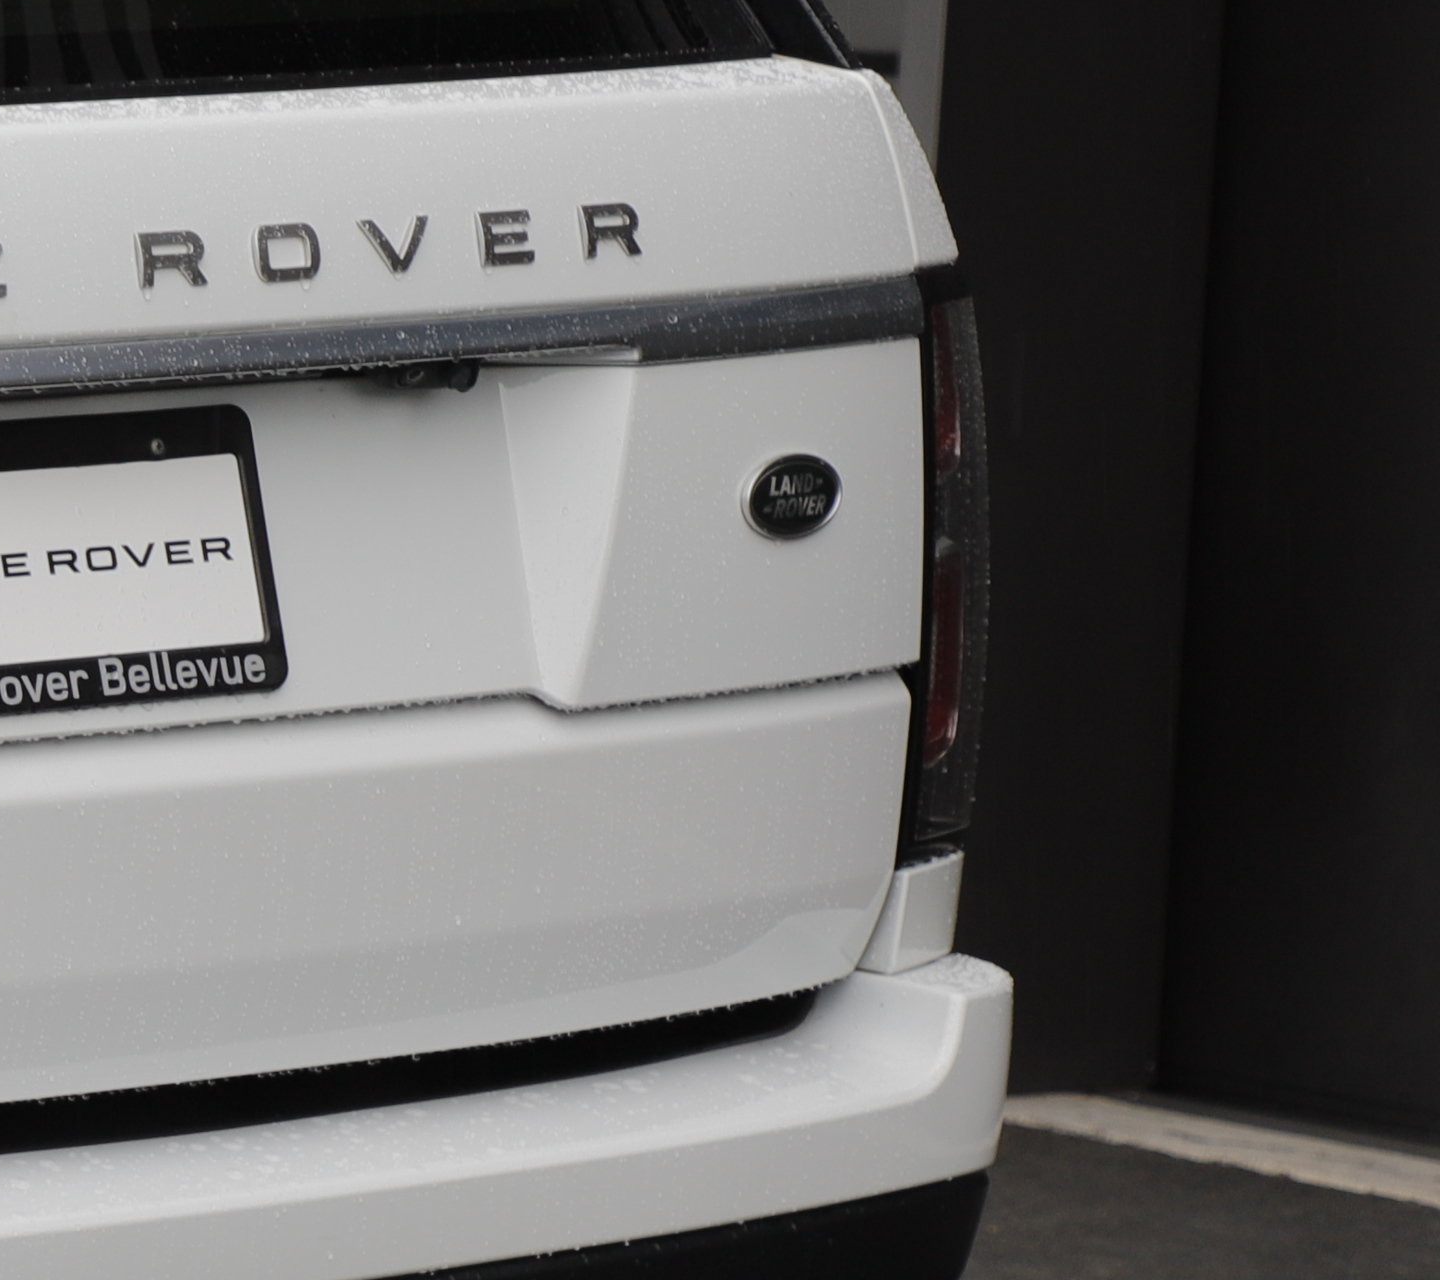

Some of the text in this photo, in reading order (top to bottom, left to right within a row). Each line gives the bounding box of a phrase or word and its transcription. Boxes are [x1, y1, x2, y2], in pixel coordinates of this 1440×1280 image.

[134, 202, 643, 289] ROVER
[770, 473, 813, 496] LAND
[774, 495, 826, 518] ROVER
[46, 536, 234, 576] ROVER
[98, 651, 267, 697] Bellevue
